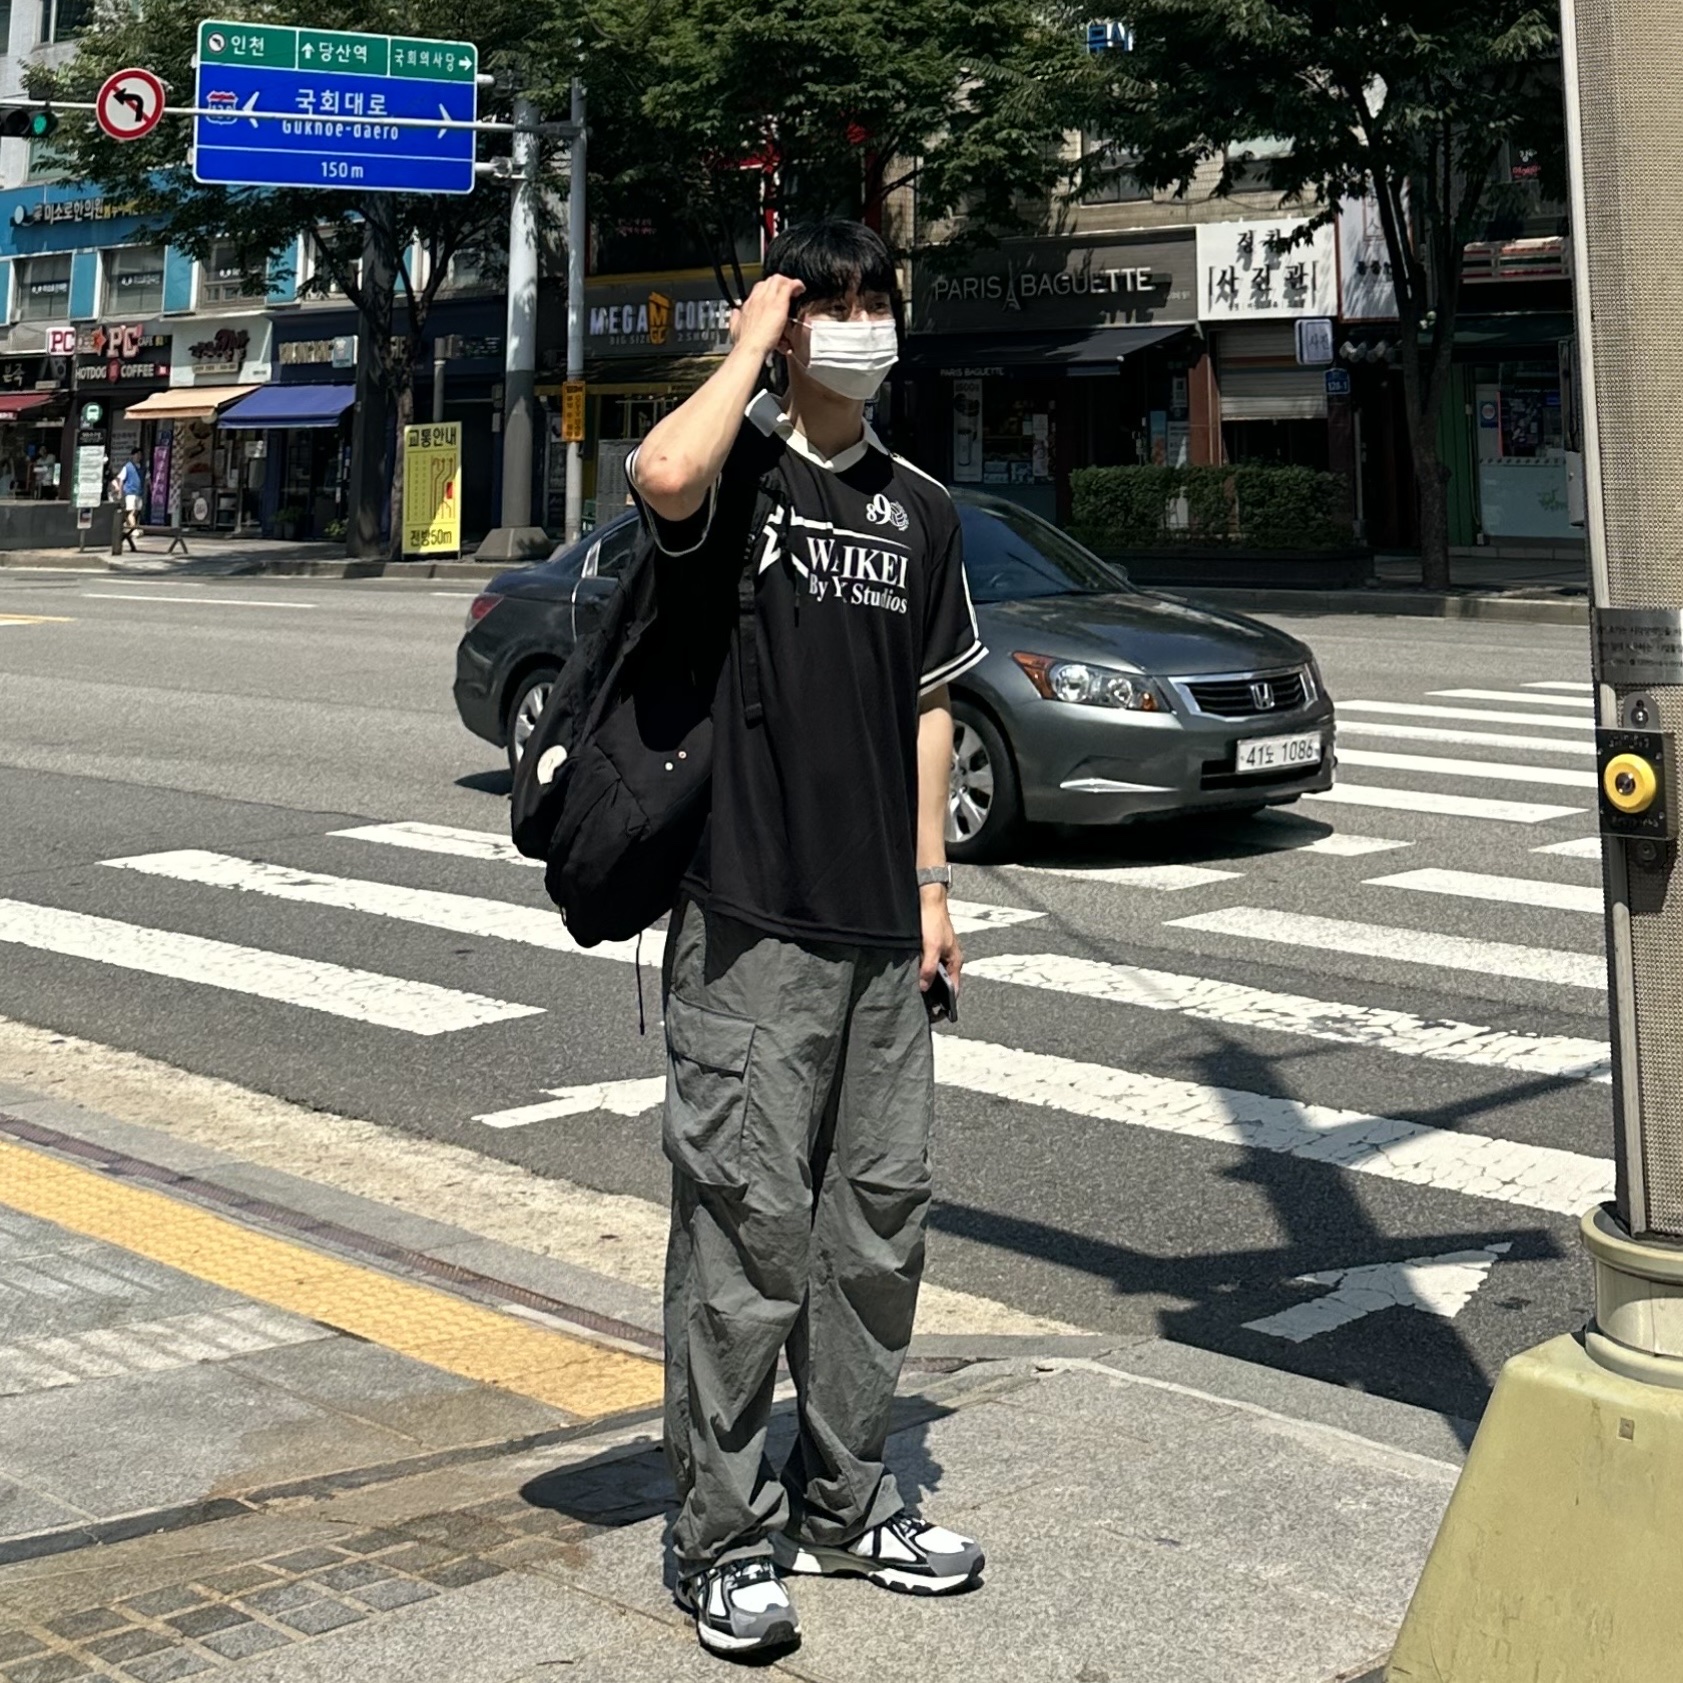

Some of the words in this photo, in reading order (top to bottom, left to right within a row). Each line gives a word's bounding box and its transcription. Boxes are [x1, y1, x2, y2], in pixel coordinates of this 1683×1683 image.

[231, 35, 265, 57] 인천
[319, 41, 368, 63] 당산역
[395, 49, 456, 73] 국회의사당
[295, 88, 388, 116] 국회대로
[934, 275, 1001, 299] PARIS
[1021, 267, 1154, 296] BAGUETTE
[1216, 262, 1309, 293] 사진관
[590, 305, 648, 335] MEGA
[674, 299, 742, 331] COFFE
[51, 331, 75, 352] PC
[75, 364, 107, 380] HOTDOG
[120, 363, 155, 378] COFFEE
[408, 427, 456, 447] 교통안내
[809, 573, 829, 602] By
[1283, 739, 1313, 762] 1086
